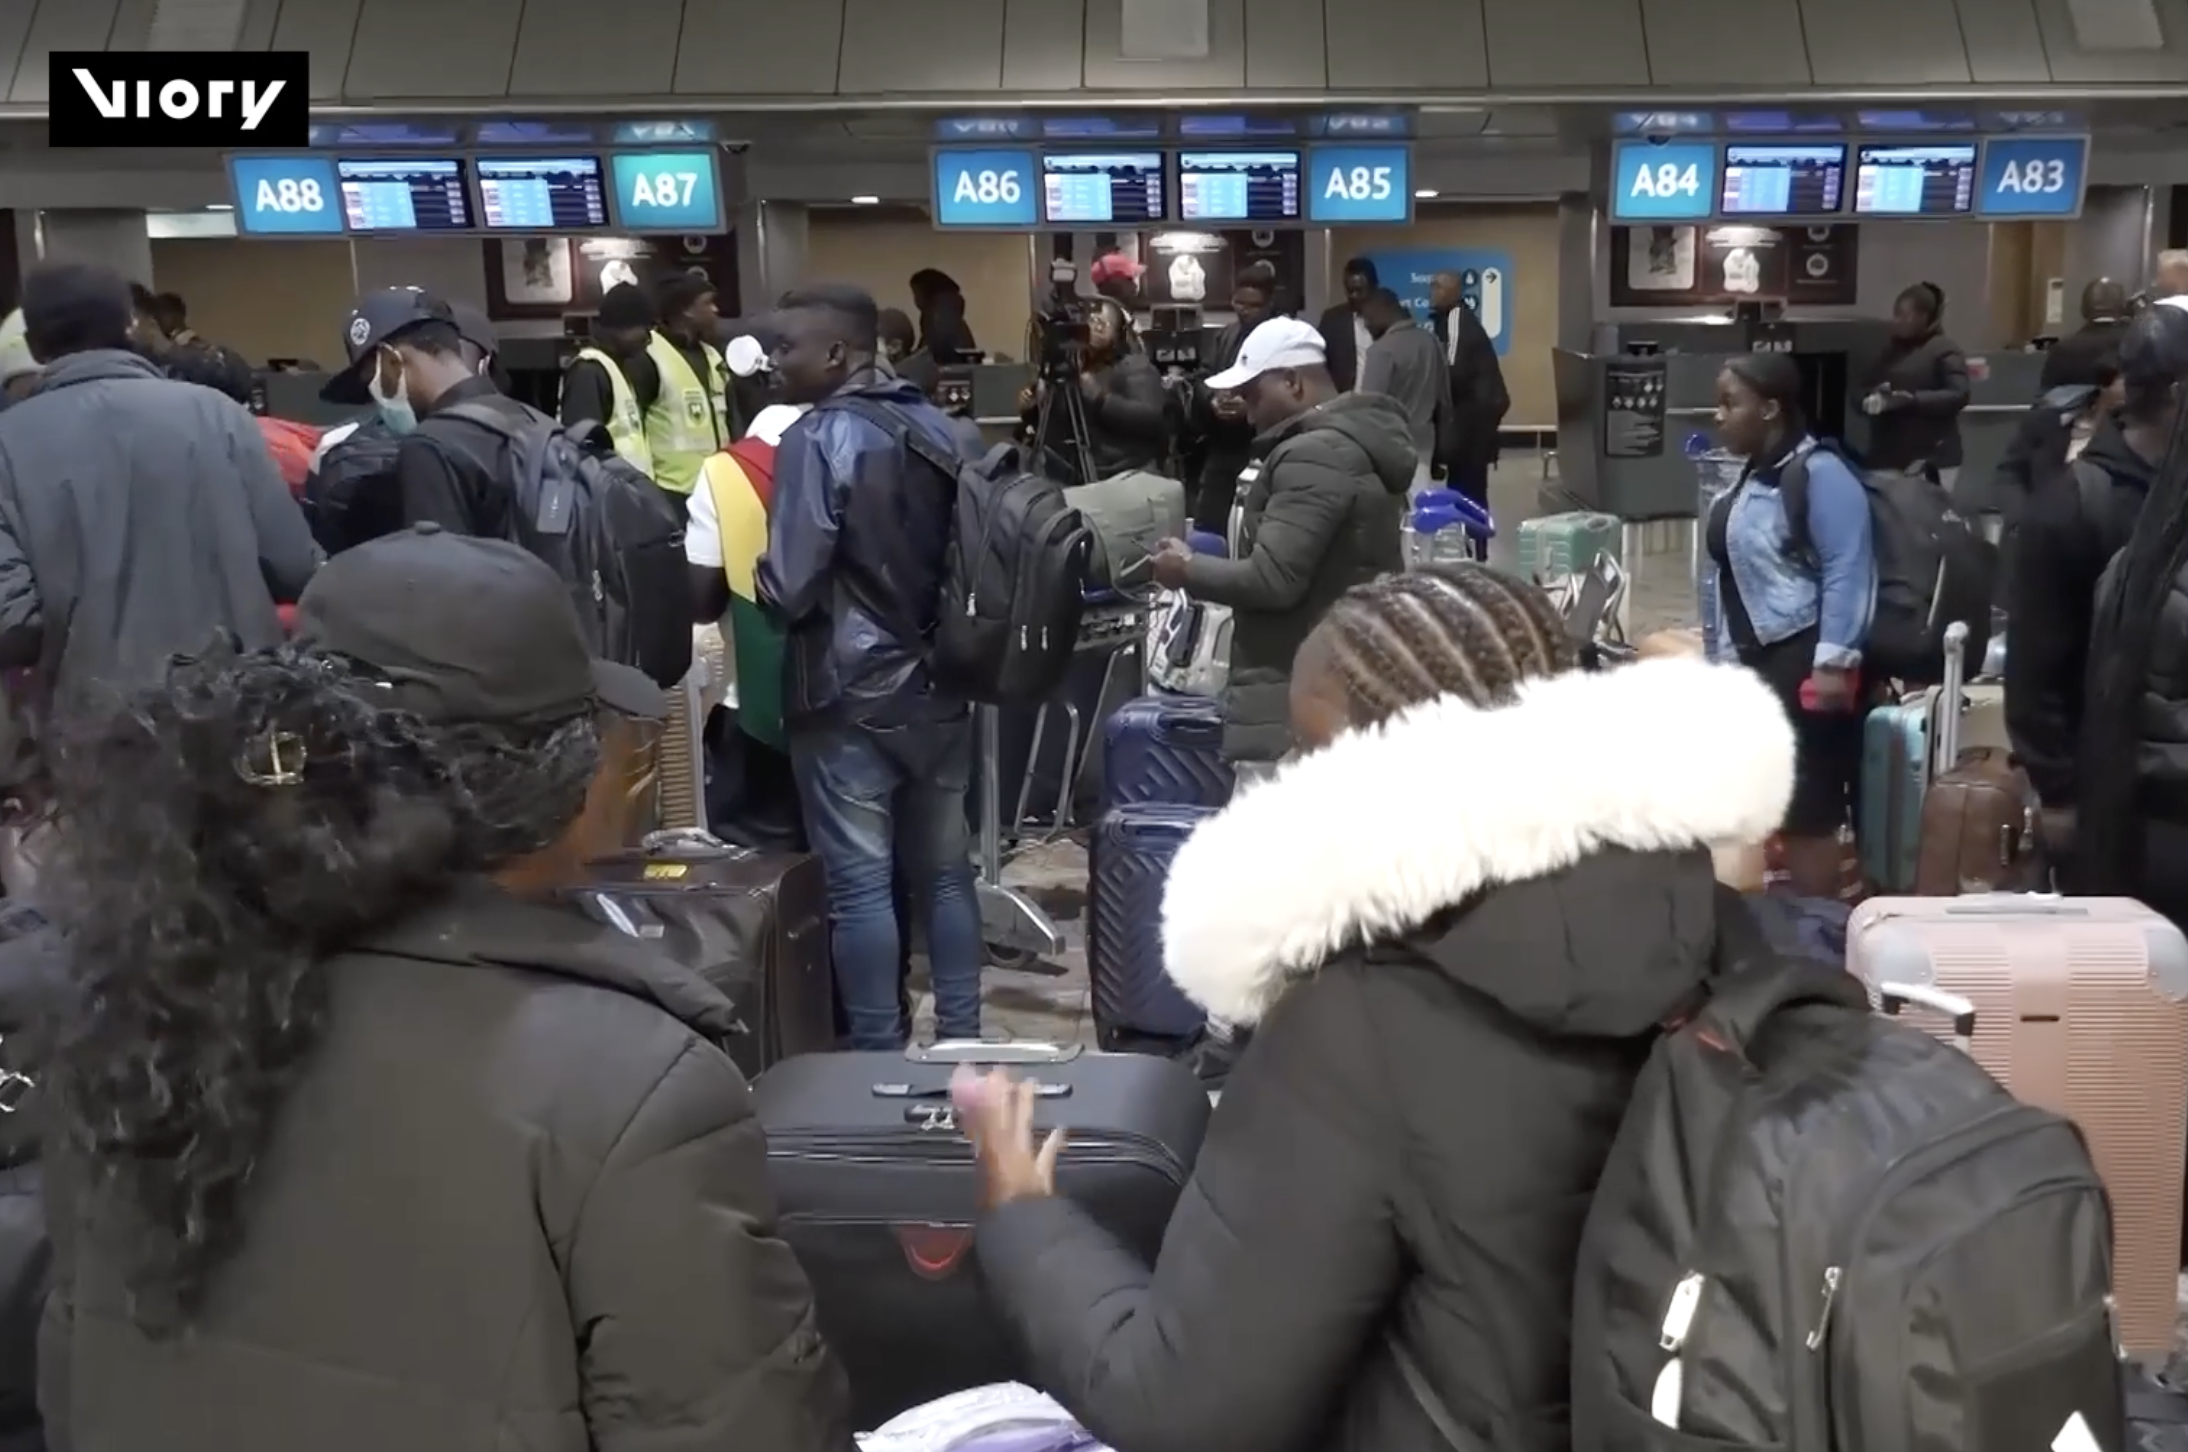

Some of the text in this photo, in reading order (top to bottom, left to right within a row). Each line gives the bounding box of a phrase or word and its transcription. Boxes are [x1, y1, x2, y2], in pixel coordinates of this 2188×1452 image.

[632, 172, 699, 208] A87
[953, 170, 1021, 204] A86
[1324, 167, 1391, 200] A85
[1630, 162, 1700, 198] A84
[1997, 160, 2064, 193] A83
[255, 178, 324, 213] A88
